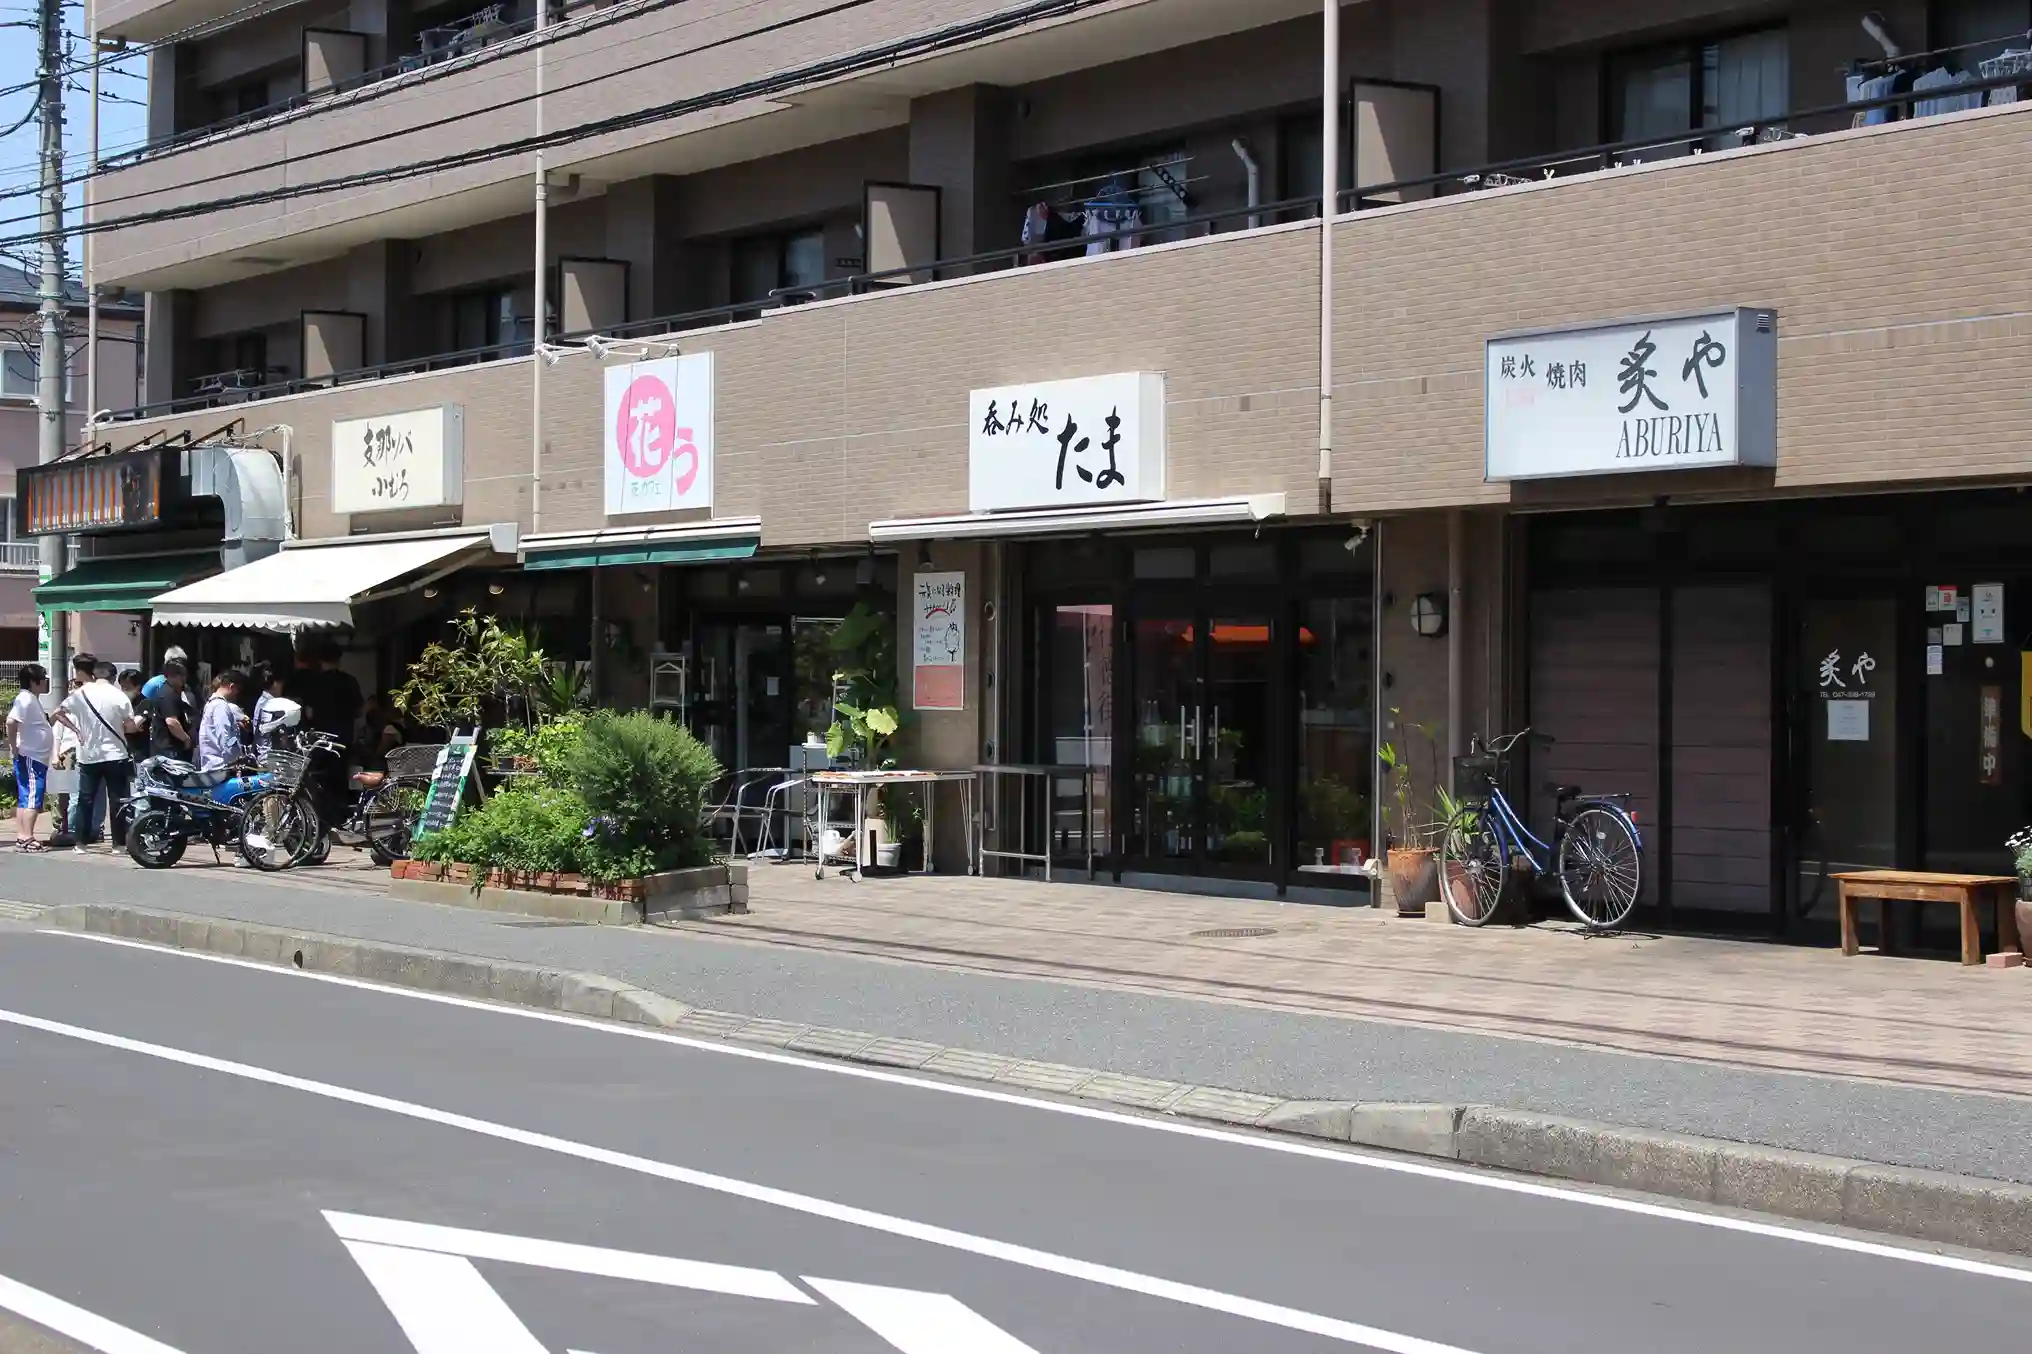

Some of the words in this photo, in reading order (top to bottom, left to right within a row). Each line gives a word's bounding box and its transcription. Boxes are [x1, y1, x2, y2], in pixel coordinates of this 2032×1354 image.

[1500, 353, 1537, 380] 炭火
[1546, 360, 1587, 390] 焼肉
[982, 397, 1050, 436] 呑み処
[1616, 412, 1724, 458] ABURIYA
[1056, 405, 1126, 491] たま
